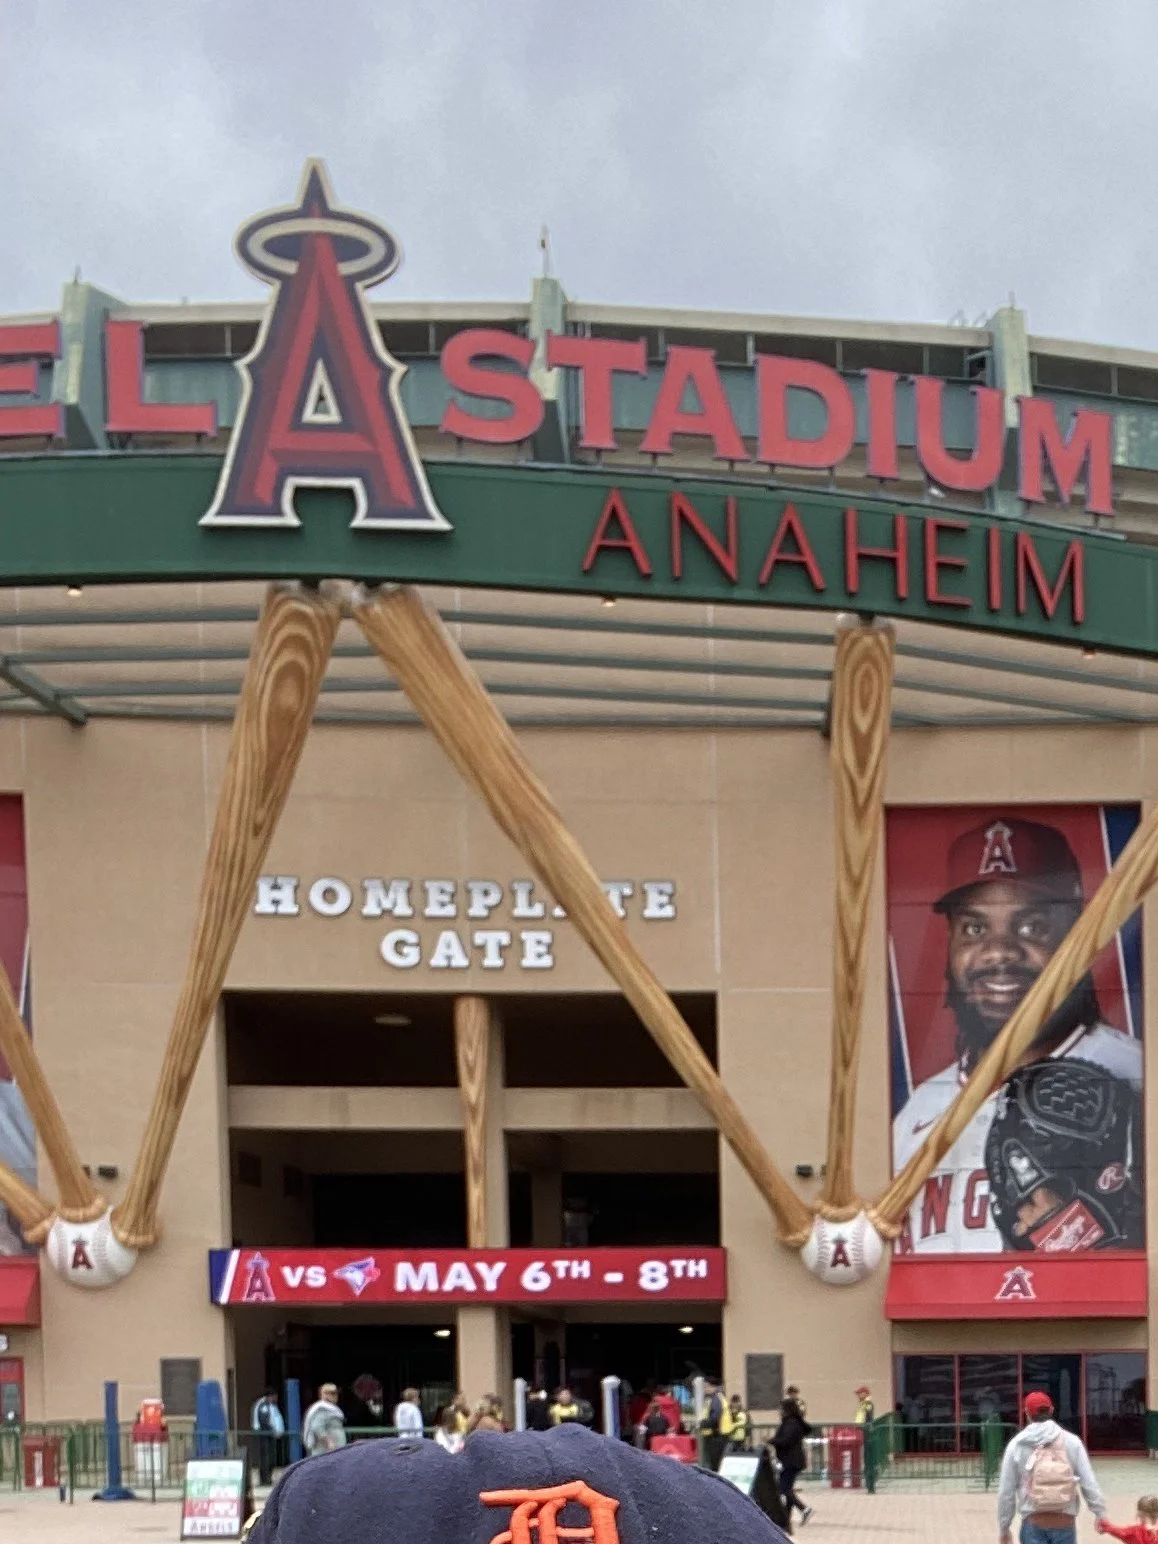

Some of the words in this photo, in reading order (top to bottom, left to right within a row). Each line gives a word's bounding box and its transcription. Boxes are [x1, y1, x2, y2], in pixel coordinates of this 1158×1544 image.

[440, 328, 1114, 516] STADIUM
[582, 486, 1084, 626] ANAHEIM
[254, 876, 677, 919] HOMEPLTE
[380, 929, 554, 969] GATE
[395, 1261, 506, 1292] MAY
[521, 1259, 590, 1292] 6TH
[638, 1258, 708, 1291] 8TH
